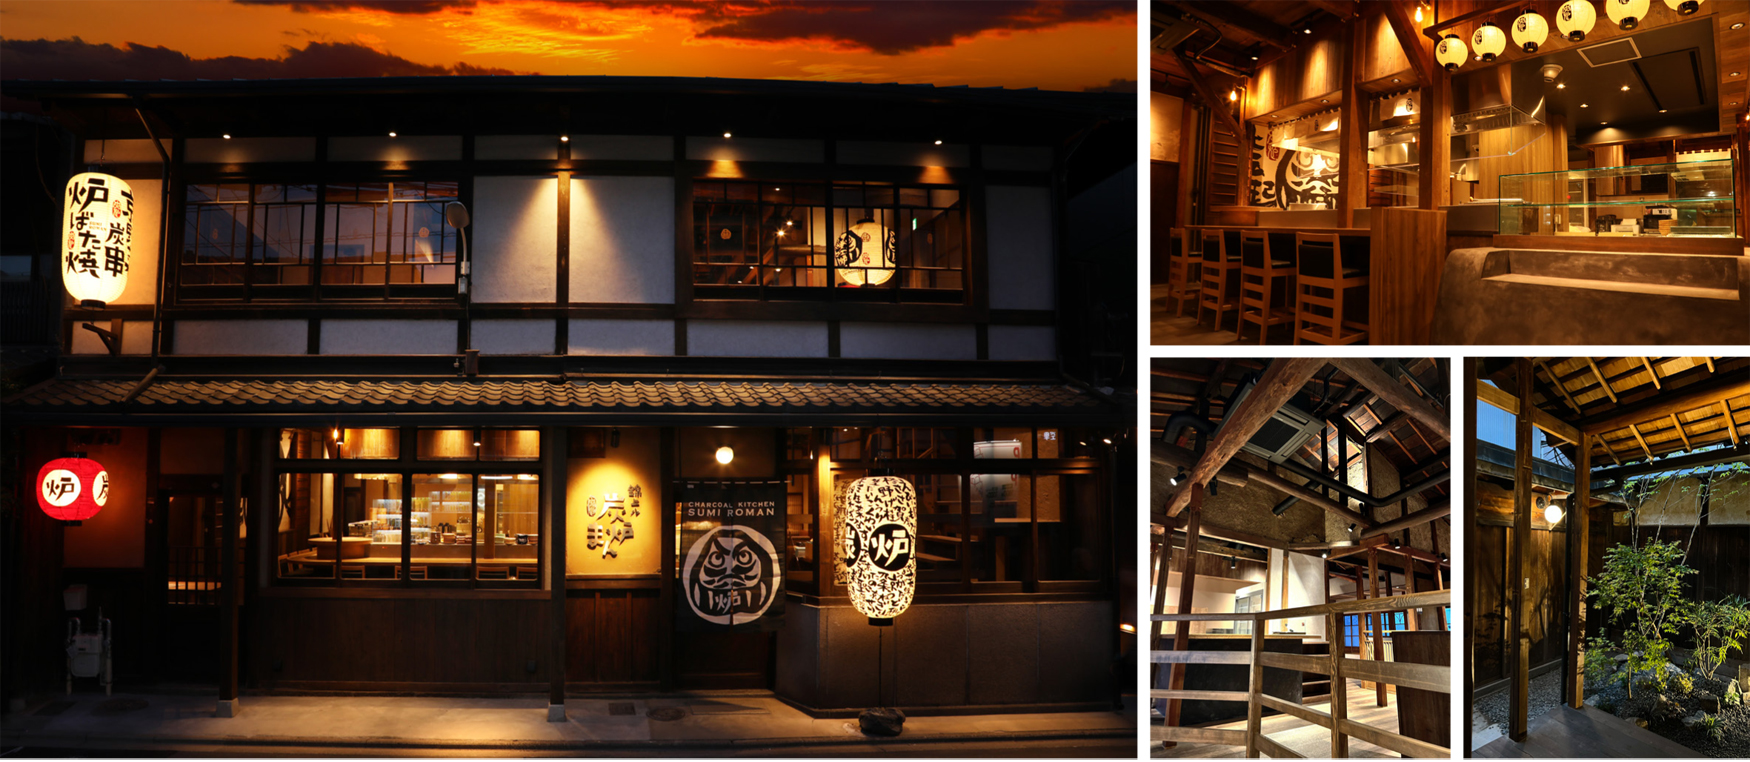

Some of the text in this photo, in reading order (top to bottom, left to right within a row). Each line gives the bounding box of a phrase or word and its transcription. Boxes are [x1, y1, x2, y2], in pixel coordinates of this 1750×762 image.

[65, 178, 109, 279] 炉ばた焼
[104, 222, 125, 277] 炭串
[46, 477, 75, 502] 炉
[688, 508, 775, 517] SUMI ROMAN
[870, 530, 909, 567] 炉
[715, 591, 741, 614] 炉
